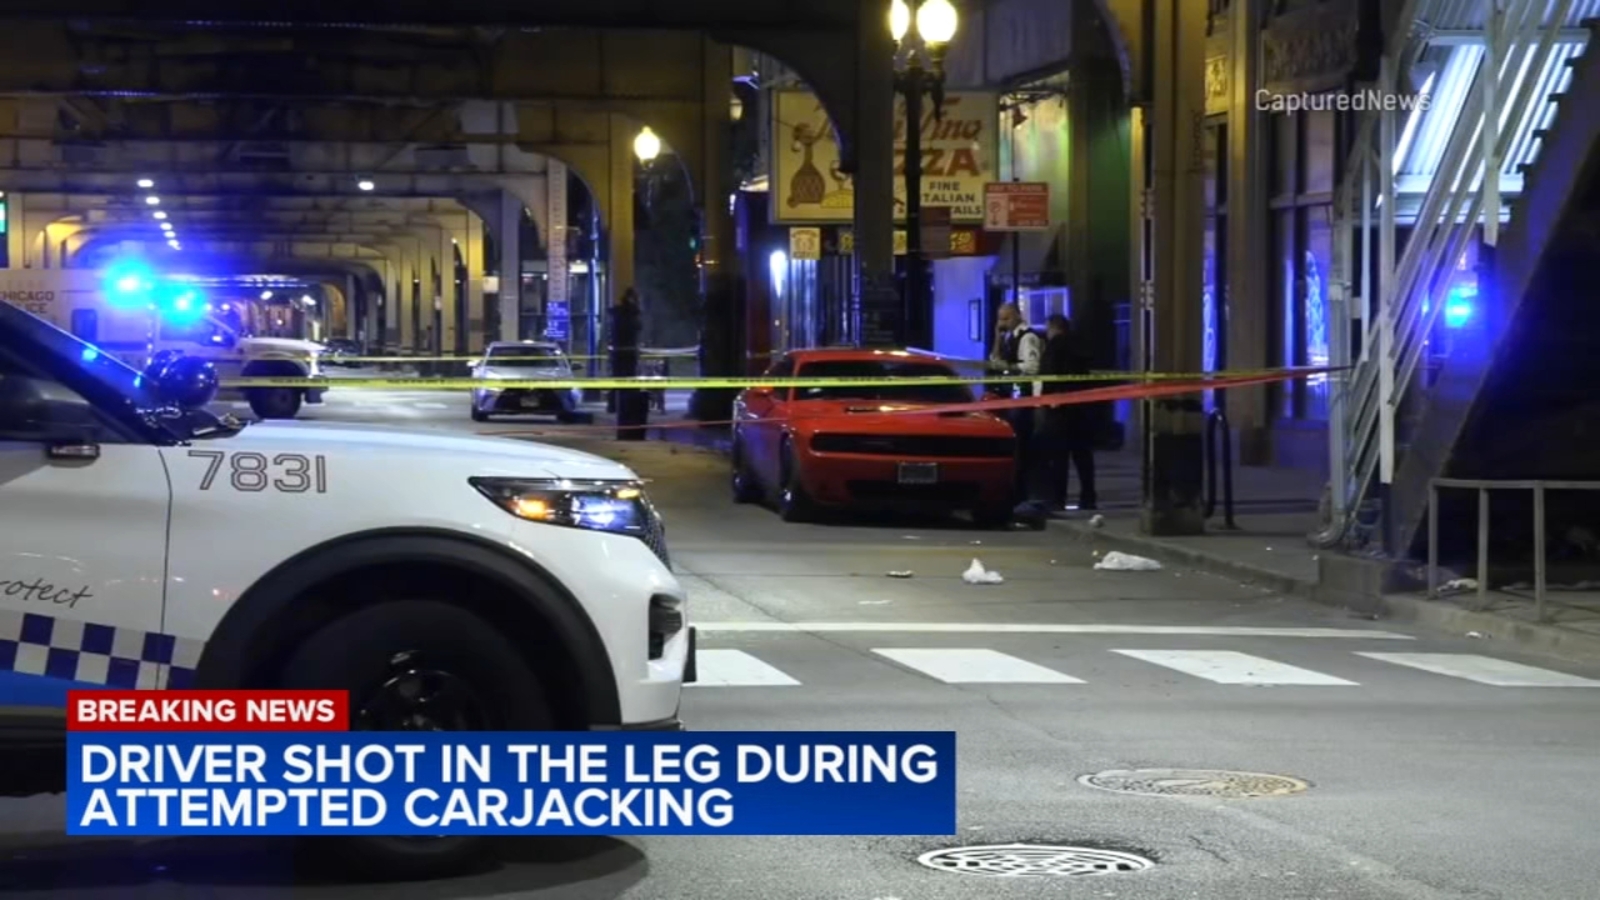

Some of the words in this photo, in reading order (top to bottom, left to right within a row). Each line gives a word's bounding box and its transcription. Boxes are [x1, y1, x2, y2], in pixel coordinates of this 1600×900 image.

[929, 181, 960, 191] FINE
[923, 193, 975, 203] TALIAN
[188, 450, 327, 493] 7831
